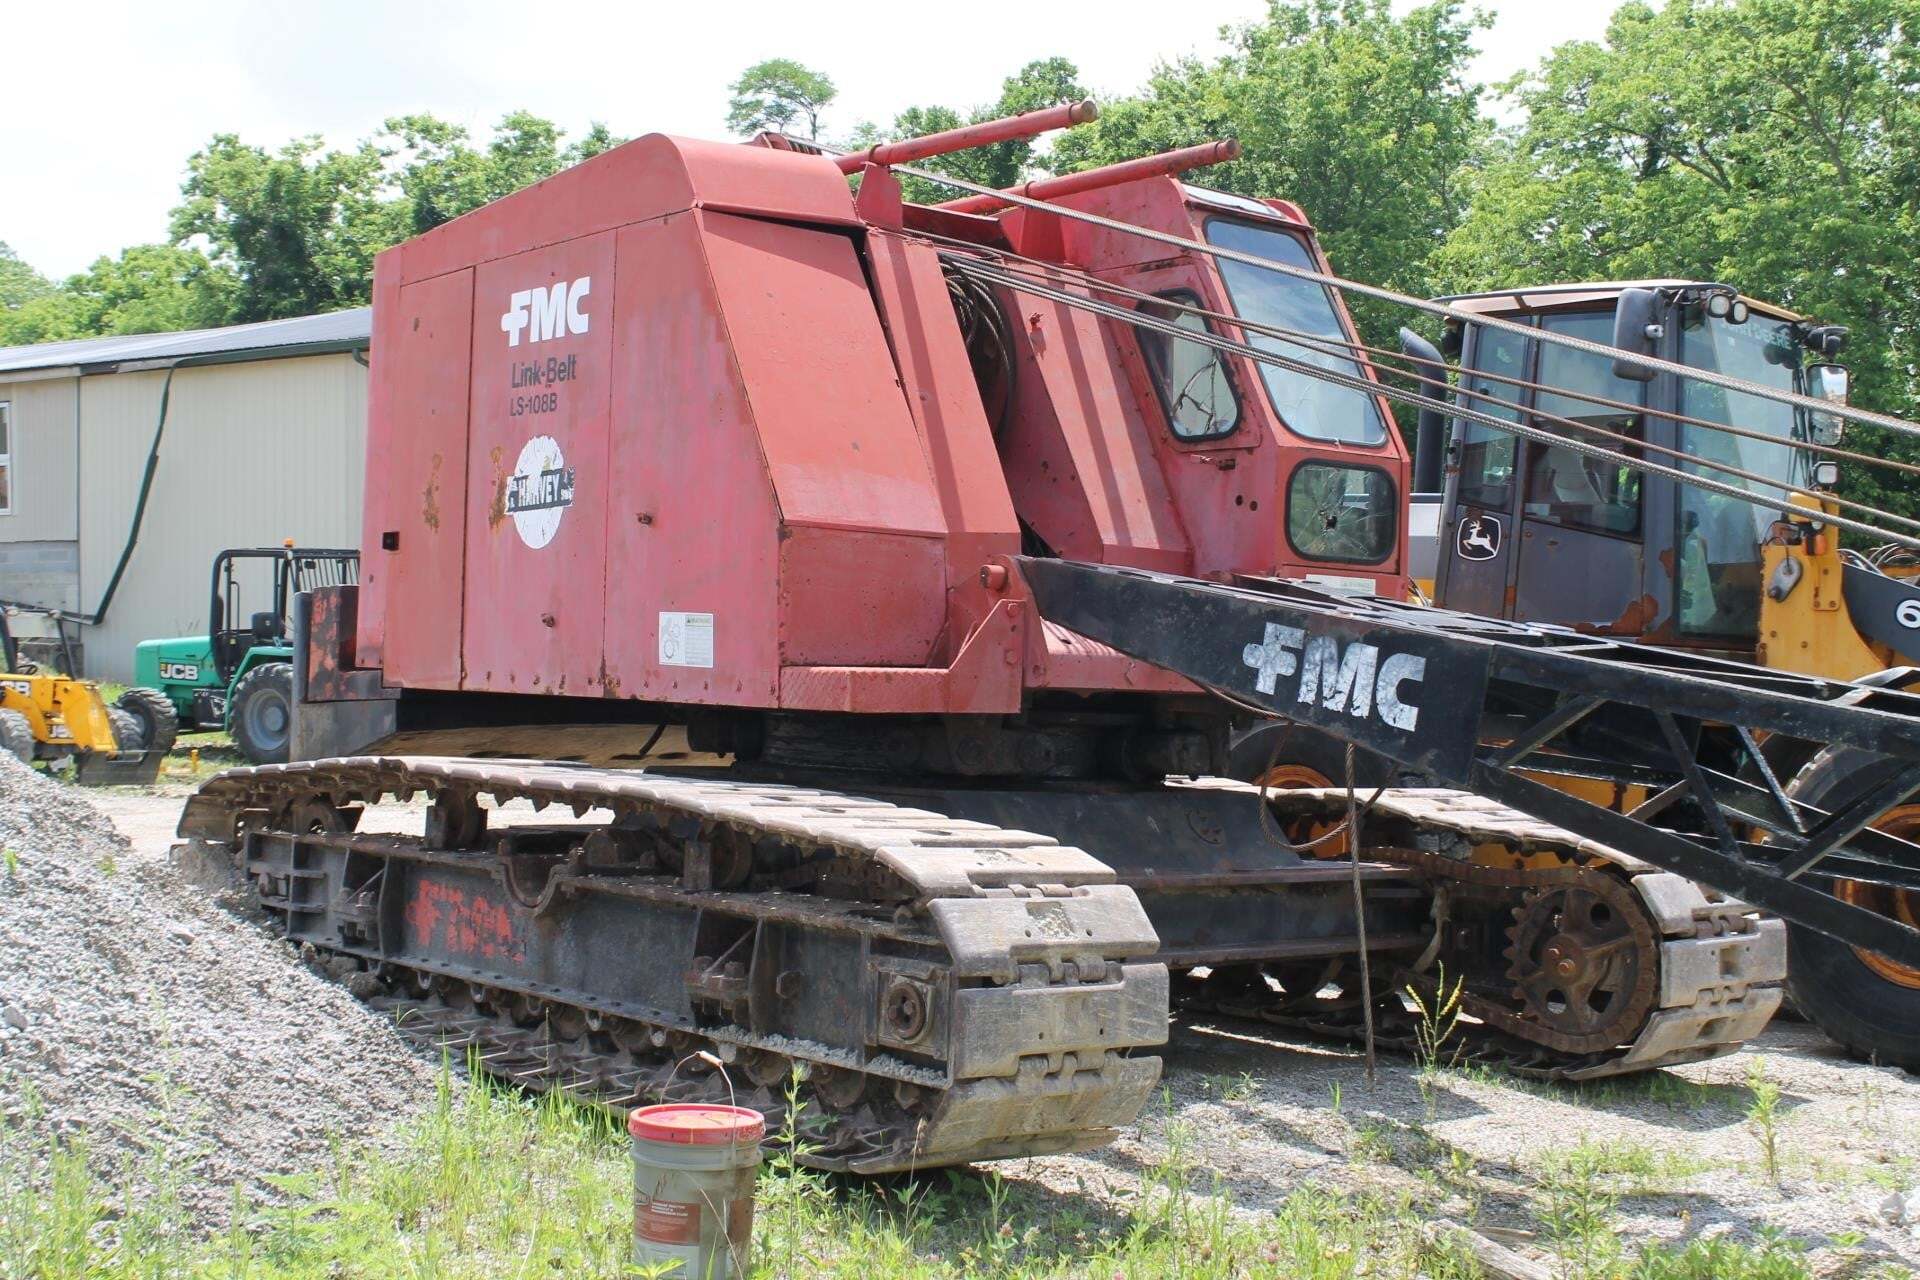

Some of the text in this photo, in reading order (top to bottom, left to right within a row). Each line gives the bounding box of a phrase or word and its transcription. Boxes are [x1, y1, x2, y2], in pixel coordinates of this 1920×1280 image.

[501, 276, 590, 347] FMC
[511, 354, 577, 389] Link-Belt
[510, 393, 558, 417] LS-108B
[160, 663, 199, 681] JCB
[1242, 622, 1427, 732] FMC
